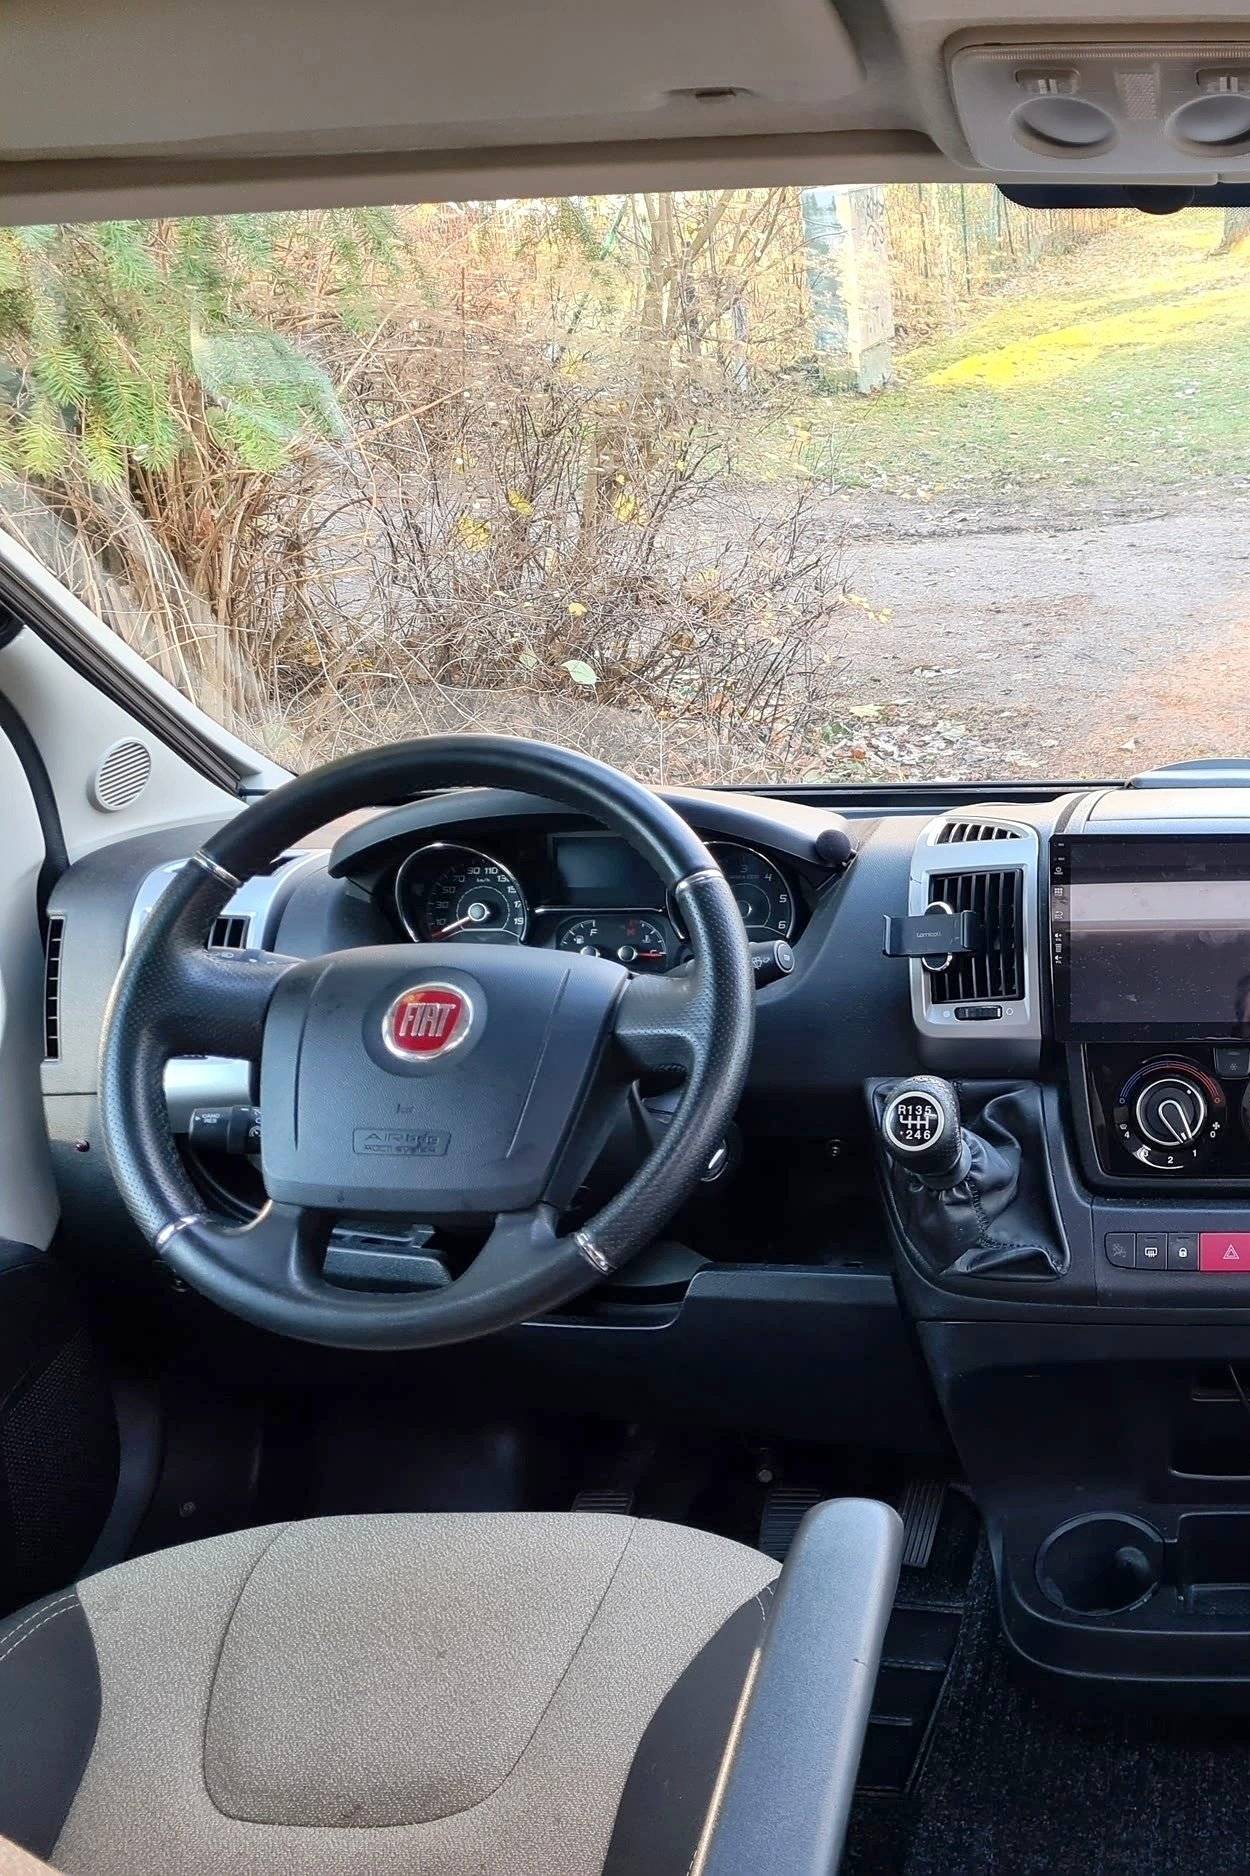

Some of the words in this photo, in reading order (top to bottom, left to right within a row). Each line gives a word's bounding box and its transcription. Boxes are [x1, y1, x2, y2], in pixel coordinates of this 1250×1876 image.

[484, 867, 499, 875] 110
[740, 864, 749, 873] 3
[779, 894, 788, 903] 5
[778, 920, 787, 929] 6
[589, 928, 598, 936] F
[398, 1002, 456, 1037] FIAT
[1167, 1156, 1173, 1164] 2
